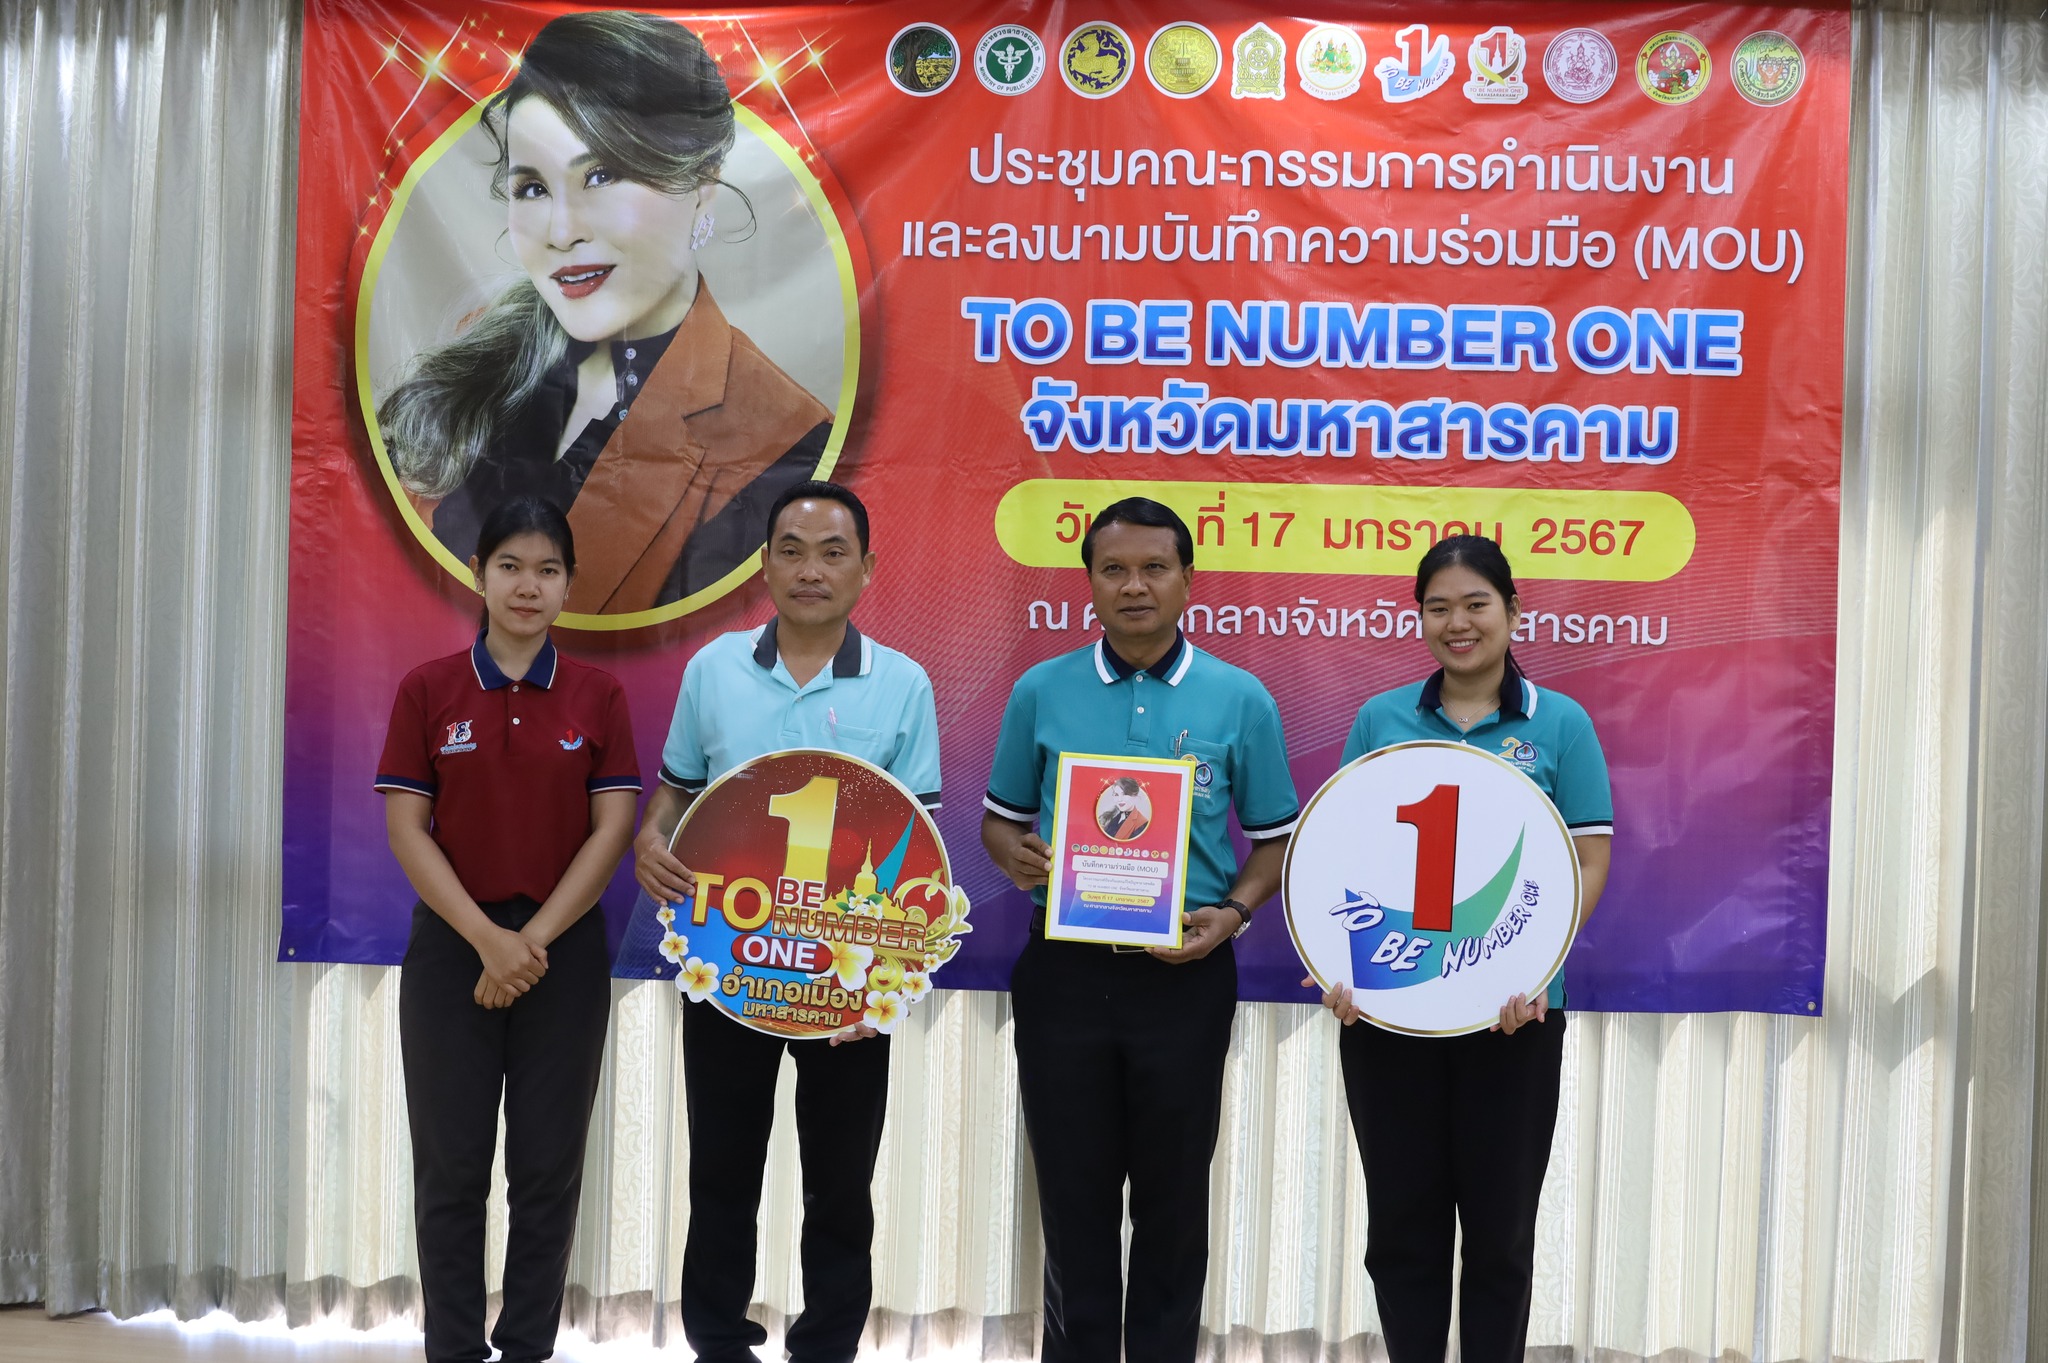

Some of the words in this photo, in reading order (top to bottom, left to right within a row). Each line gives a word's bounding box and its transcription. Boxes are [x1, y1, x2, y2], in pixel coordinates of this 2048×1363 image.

[980, 66, 996, 87] MINISTRY
[1006, 83, 1026, 92] PUBLIC
[1026, 66, 1040, 85] HEALTH
[1394, 76, 1415, 91] BE
[969, 132, 1735, 202] ประชุมคณะกรรมการดำเนินงาน
[902, 208, 1616, 268] และลงนามบันทึกความร่วมมือ
[1633, 225, 1805, 284] (MOU)
[961, 296, 1073, 365] TO
[1085, 299, 1193, 366] BE
[1205, 301, 1558, 373] NUMBER
[1566, 305, 1744, 377] ONE
[1019, 376, 1679, 465] จังหวัดมหาสารคาม
[1242, 511, 1296, 548] 17
[1530, 517, 1645, 556] 2567
[1027, 599, 1069, 631] ณ
[768, 775, 839, 886] 1
[1136, 865, 1159, 874] (MOU)
[1396, 783, 1460, 933] 1
[690, 871, 773, 932] TO
[775, 876, 825, 909] BE
[741, 935, 818, 971] ONE
[771, 905, 927, 953] NUMBER
[1328, 890, 1385, 932] TO
[1370, 930, 1432, 973] BE
[1440, 902, 1532, 979] NUMBER
[721, 964, 863, 1012] อำเภอเมือง
[742, 1000, 842, 1028] มหาสารคาม
